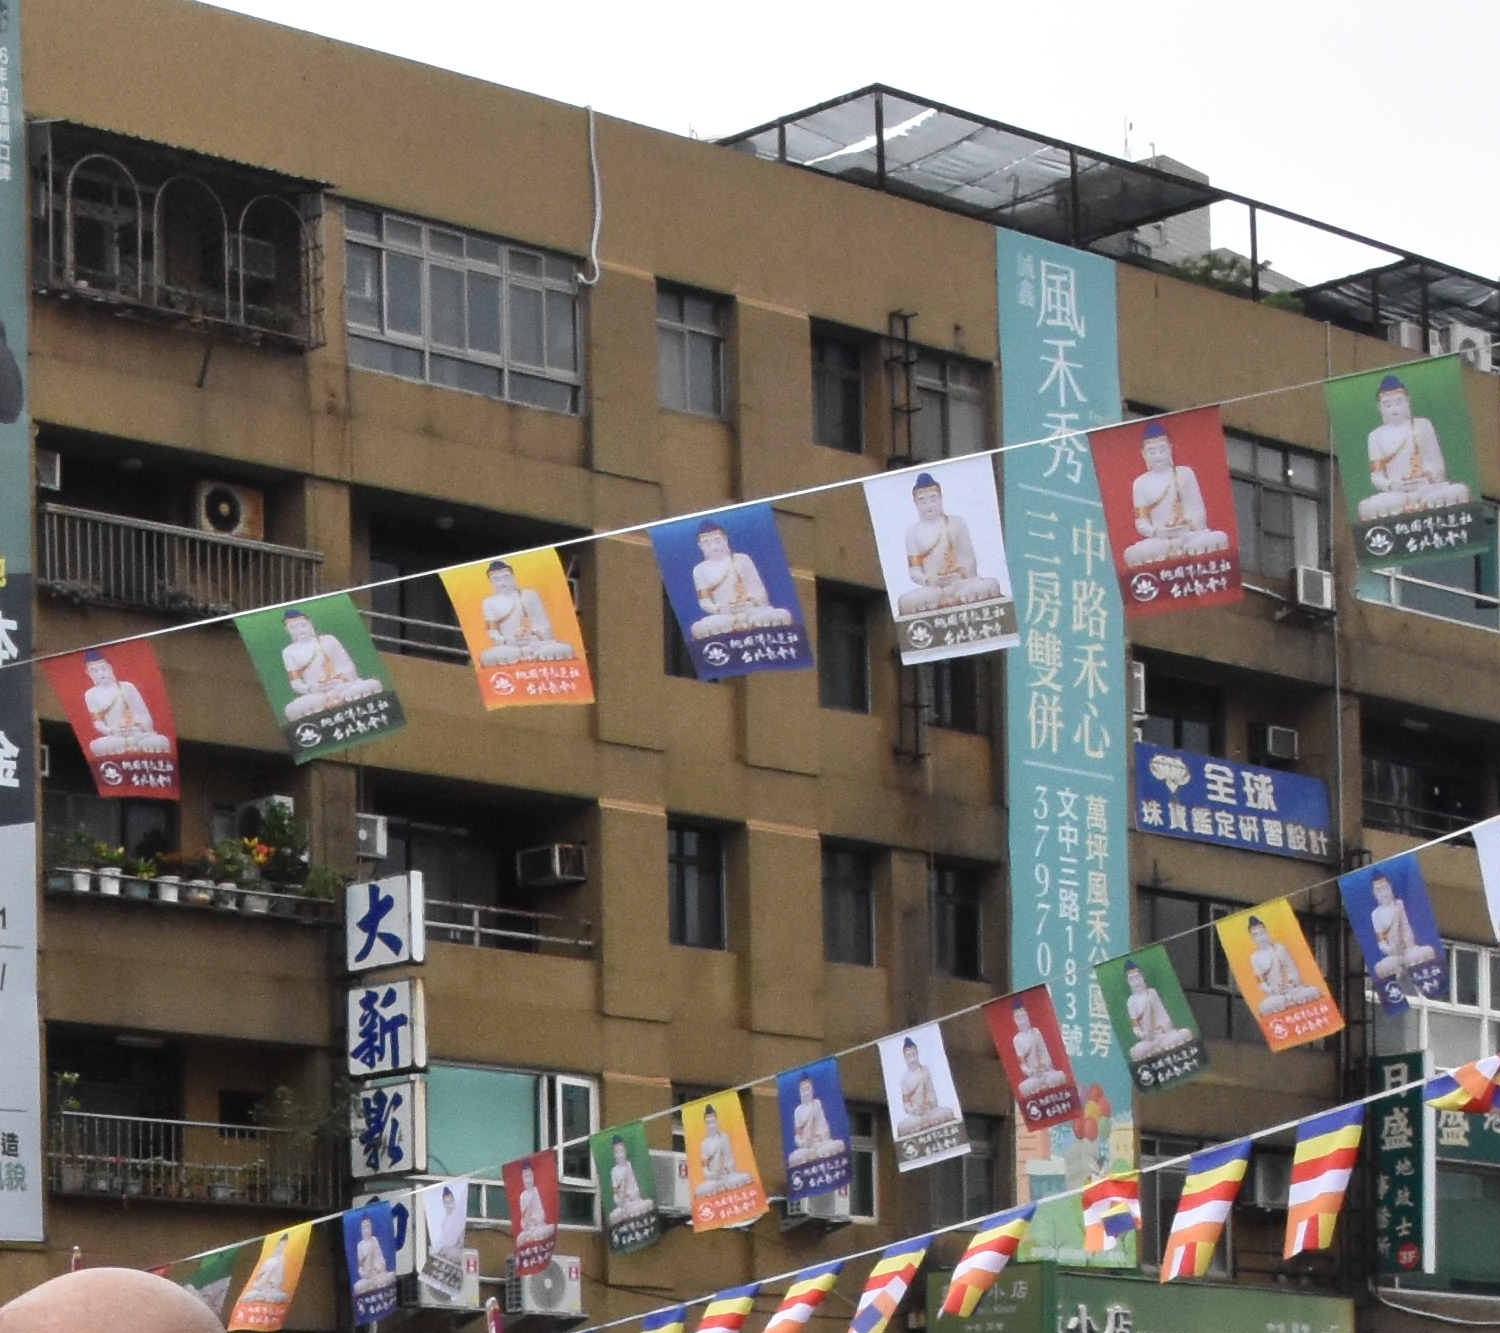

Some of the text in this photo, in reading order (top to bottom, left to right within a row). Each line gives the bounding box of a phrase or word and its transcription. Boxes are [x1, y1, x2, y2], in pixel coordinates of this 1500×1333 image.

[1037, 260, 1088, 484] 風禾秀
[1024, 508, 1065, 753] 三房雙併
[1071, 518, 1112, 759] 中路禾心
[1033, 786, 1053, 997] 37970
[1203, 762, 1278, 813] 全球
[1382, 1063, 1413, 1150] 日盛
